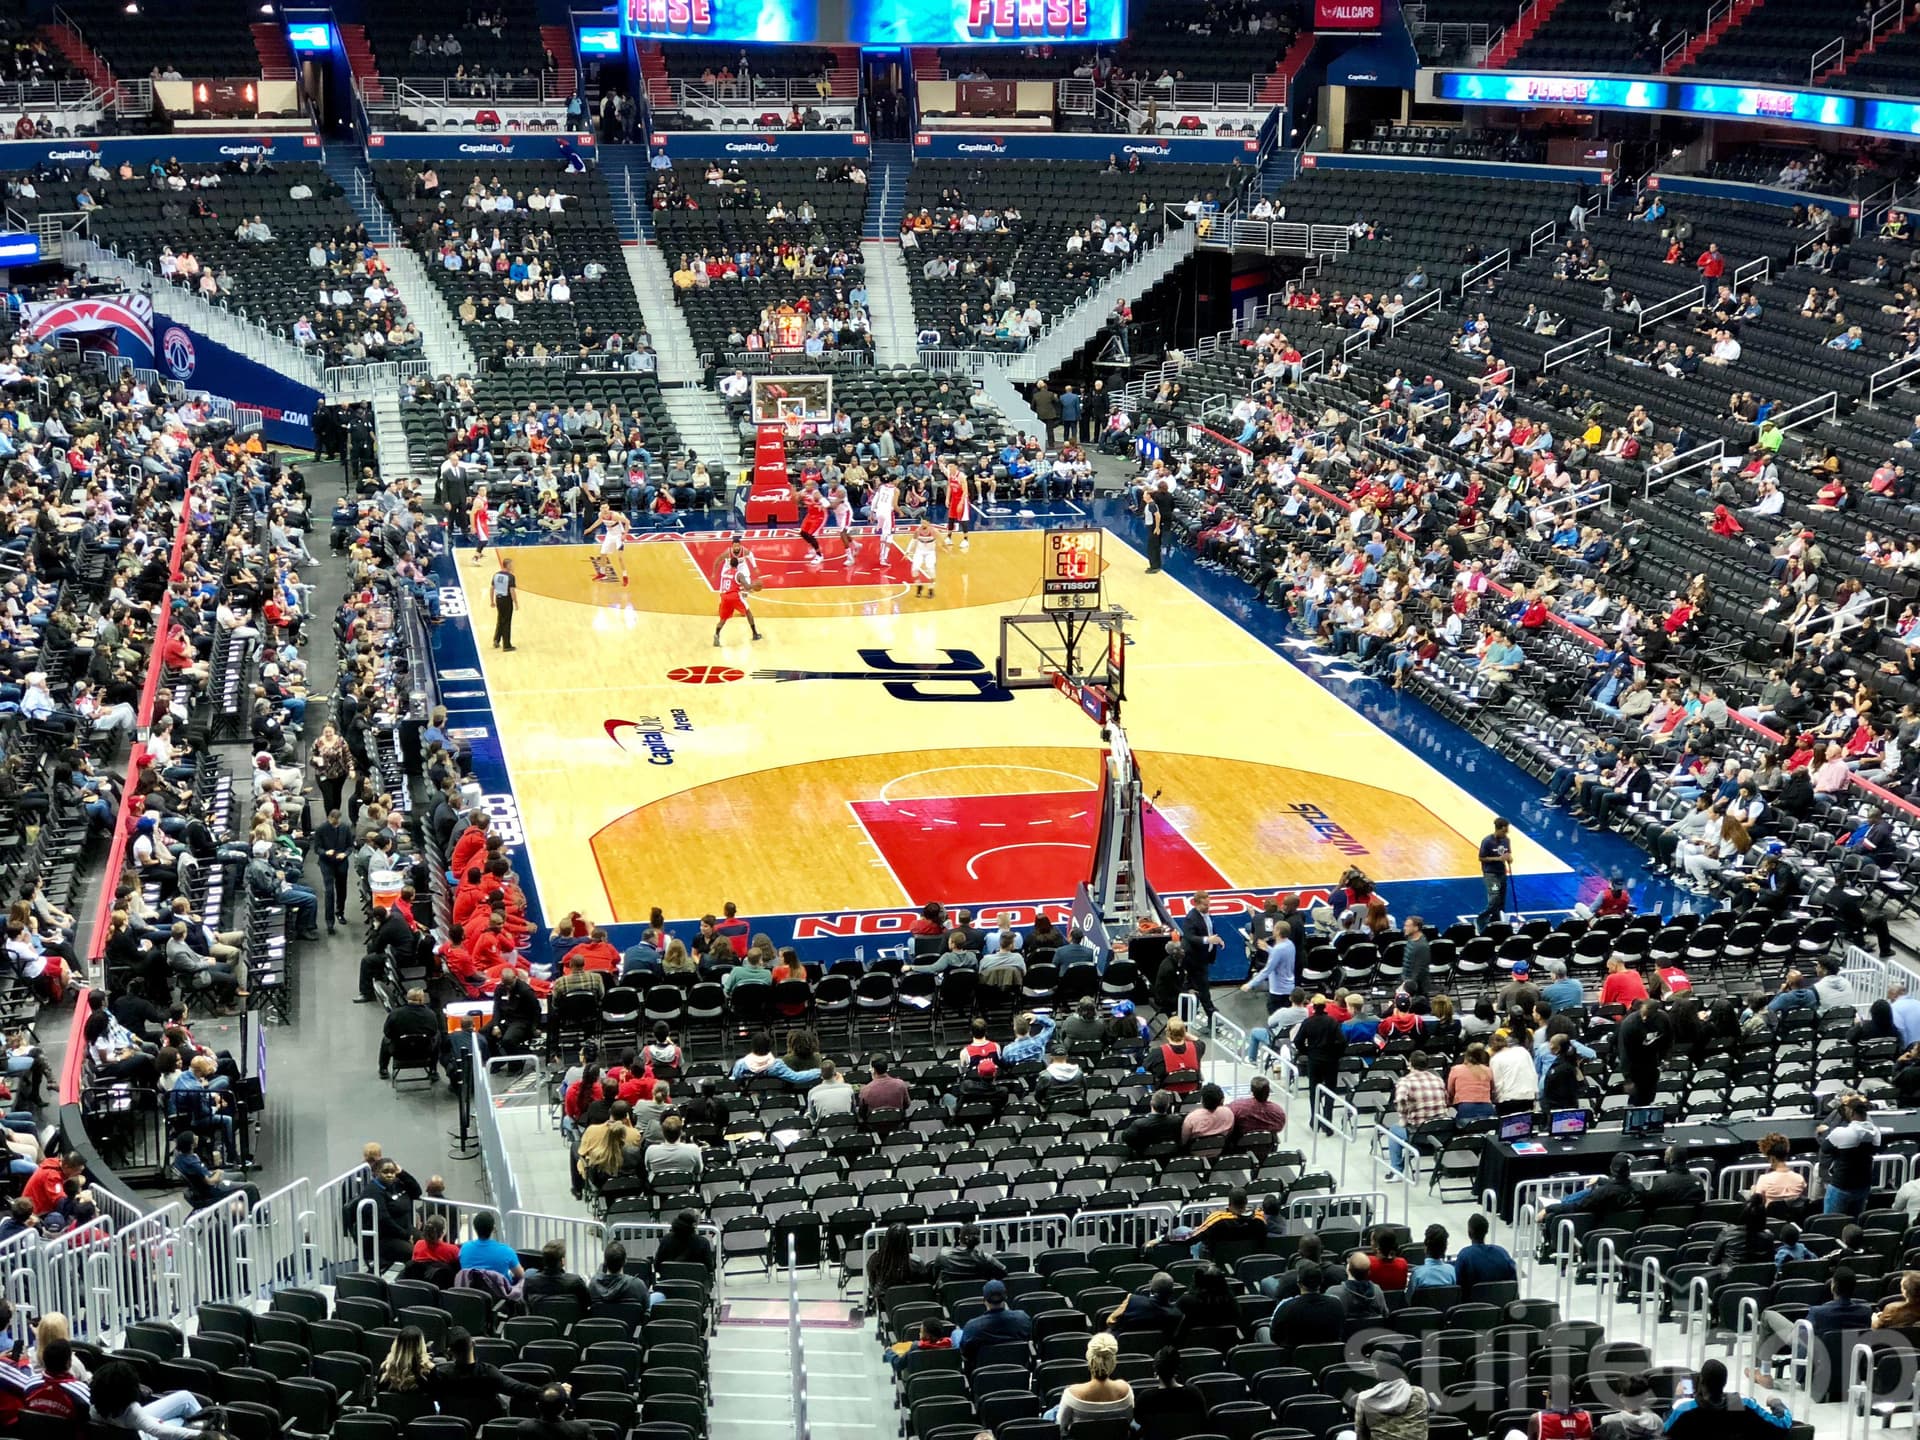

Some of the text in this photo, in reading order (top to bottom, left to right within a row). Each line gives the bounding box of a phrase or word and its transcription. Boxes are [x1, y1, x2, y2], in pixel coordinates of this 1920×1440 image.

[968, 0, 1087, 27] FENSE
[1062, 582, 1098, 590] TISSOT
[670, 709, 694, 732] Arena
